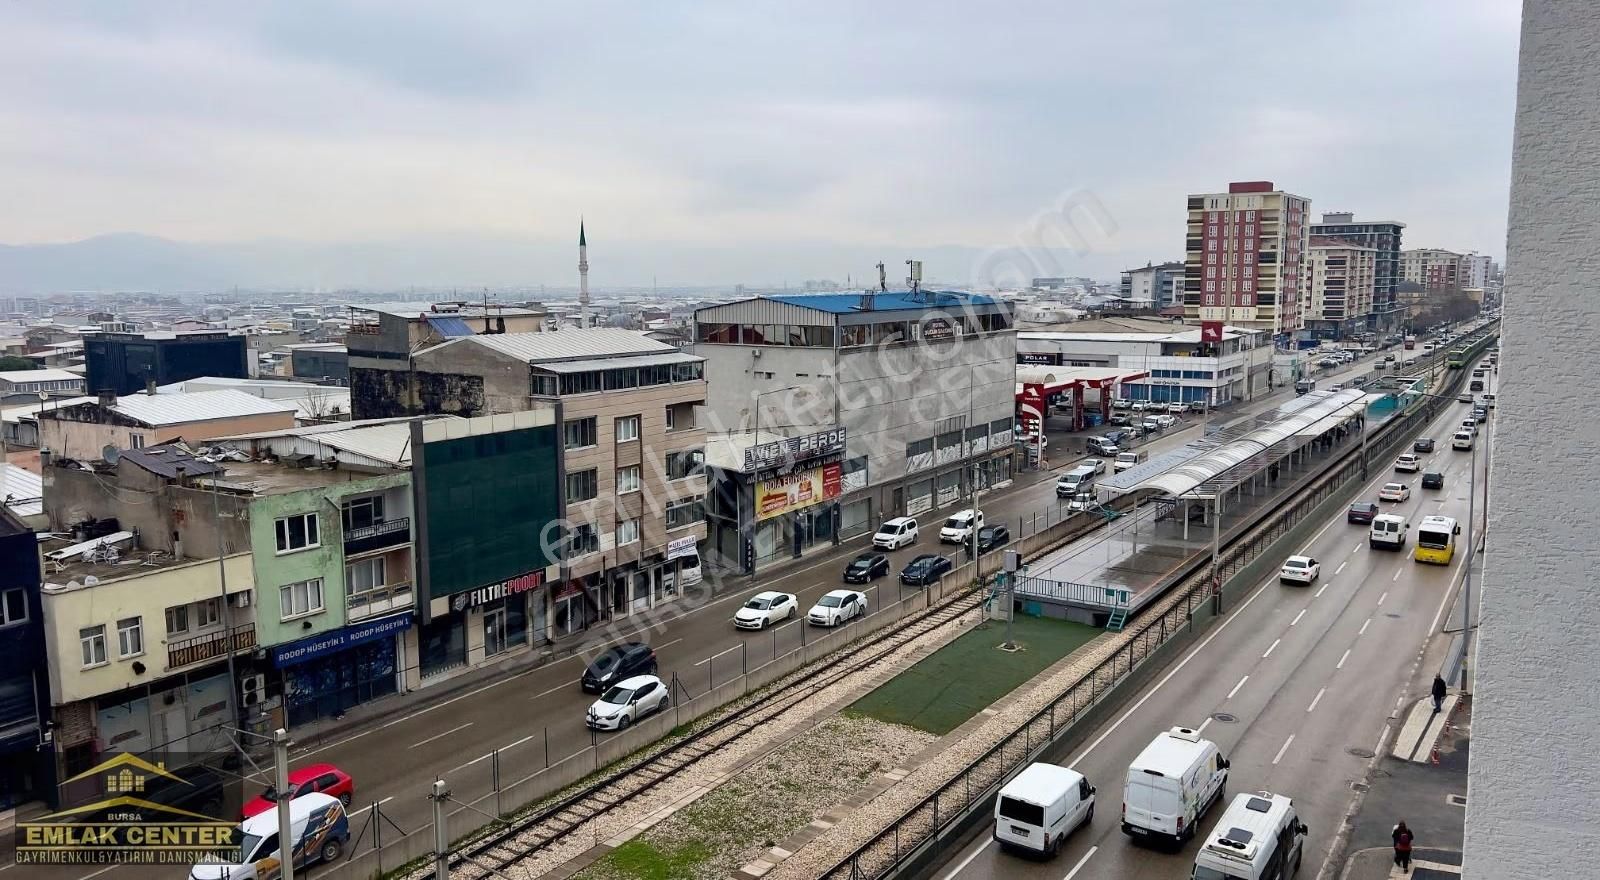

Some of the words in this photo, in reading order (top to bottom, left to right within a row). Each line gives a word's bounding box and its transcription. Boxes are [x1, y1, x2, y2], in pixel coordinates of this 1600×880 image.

[799, 429, 846, 453] PERDE
[278, 647, 306, 662] RODOP
[307, 637, 340, 653] HÜSEYİN
[350, 628, 375, 641] RODOP
